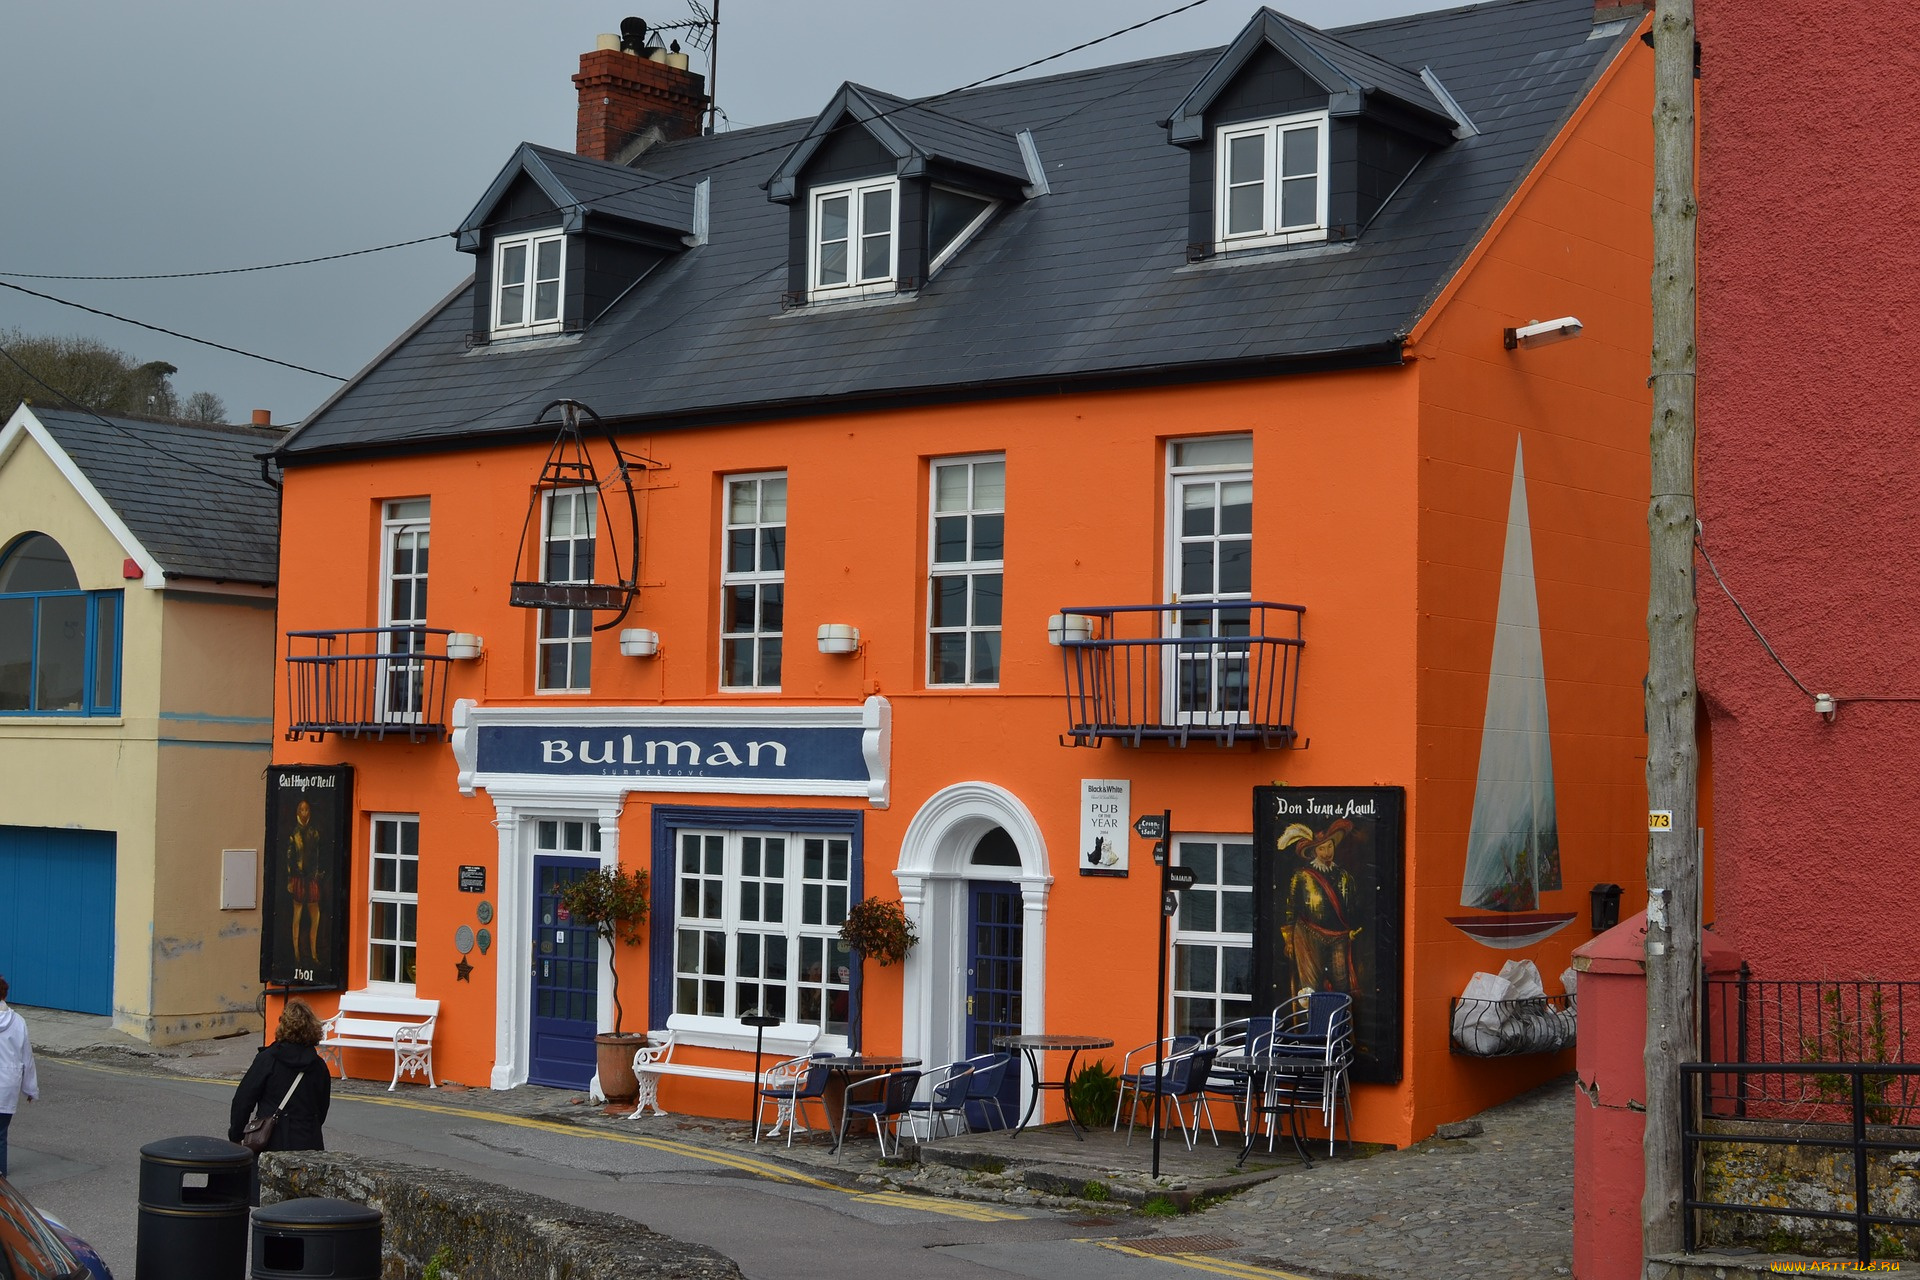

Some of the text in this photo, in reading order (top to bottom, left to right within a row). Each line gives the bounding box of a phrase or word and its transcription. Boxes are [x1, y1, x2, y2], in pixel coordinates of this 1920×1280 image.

[1091, 804, 1118, 813] PUB
[1276, 796, 1302, 815] Don
[1334, 804, 1344, 815] de
[1091, 818, 1118, 828] YEAR
[293, 968, 314, 982] 1601
